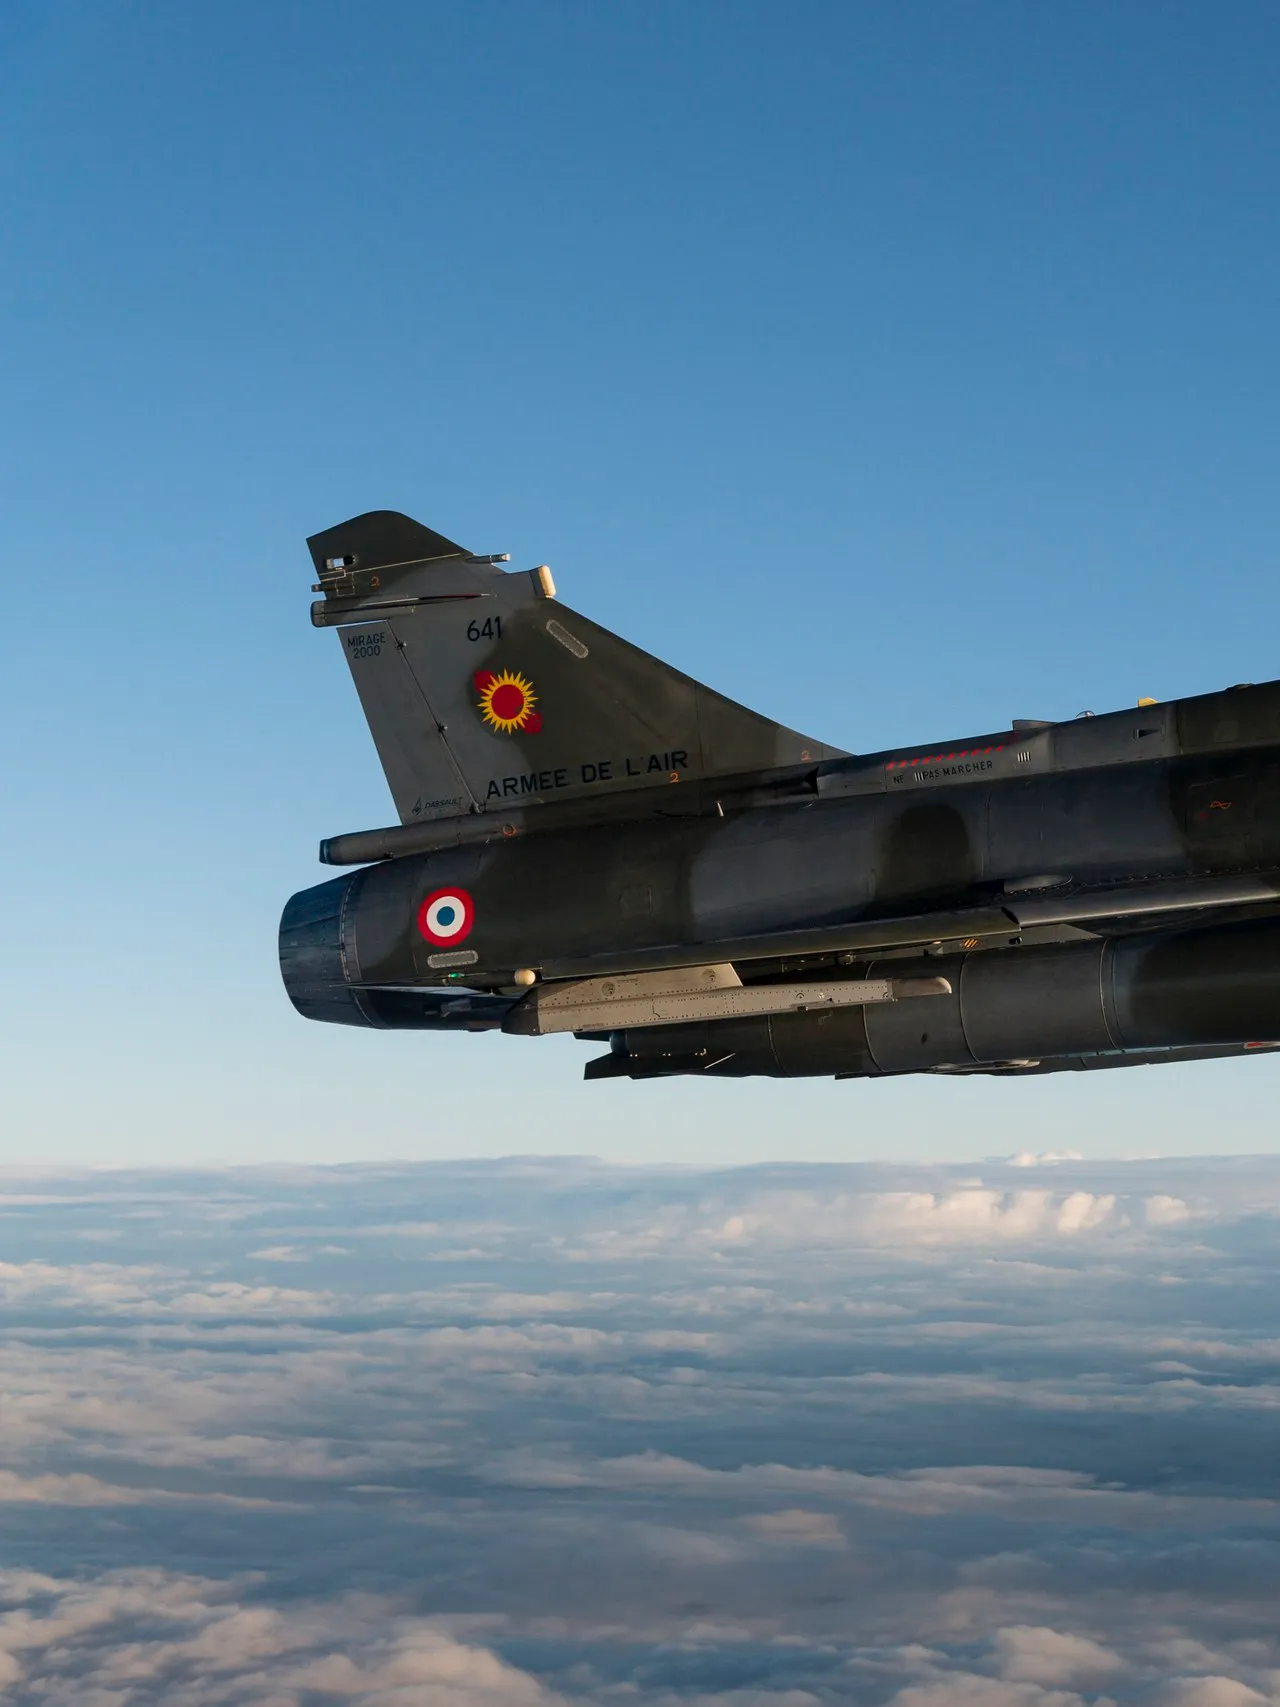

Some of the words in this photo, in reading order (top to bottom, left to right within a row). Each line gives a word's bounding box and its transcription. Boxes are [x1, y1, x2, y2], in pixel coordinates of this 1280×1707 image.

[347, 632, 386, 648] MIRAGE
[467, 616, 502, 642] 641
[353, 645, 381, 659] 2000
[487, 768, 569, 799] ARMEE
[581, 761, 613, 784] DE
[626, 750, 688, 777] L'AIR
[893, 774, 904, 784] NE
[922, 769, 940, 780] PAS
[942, 760, 993, 776] MARCHER
